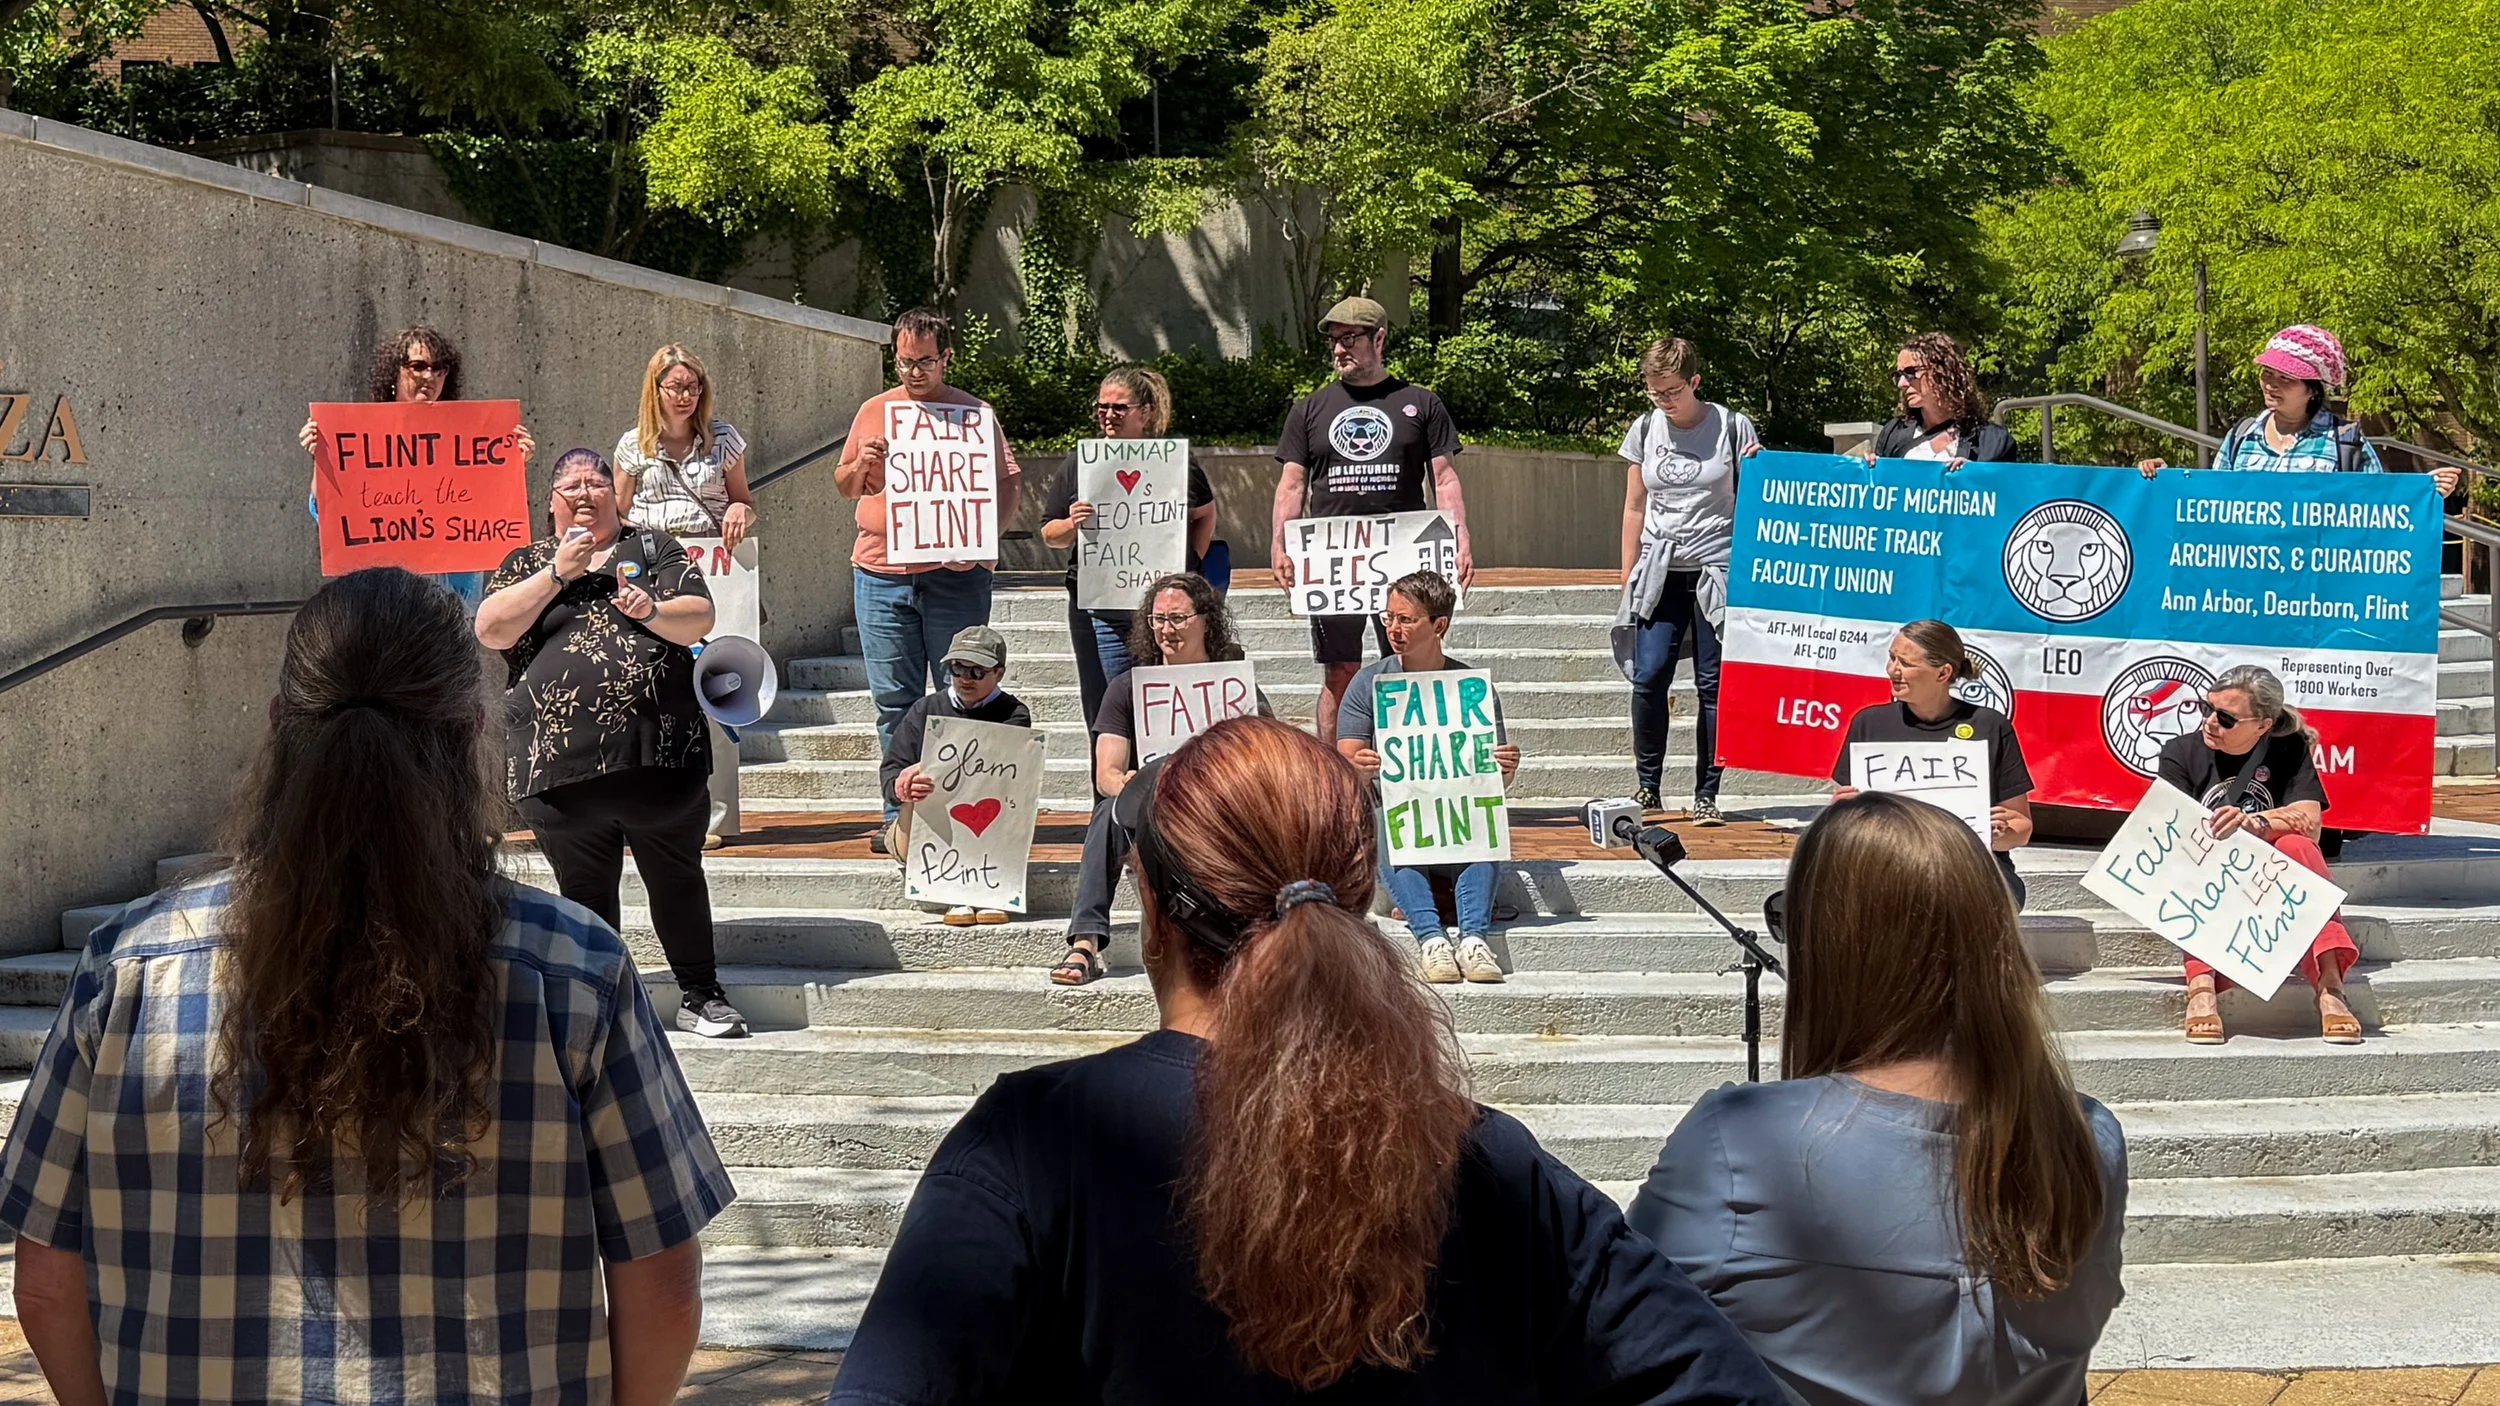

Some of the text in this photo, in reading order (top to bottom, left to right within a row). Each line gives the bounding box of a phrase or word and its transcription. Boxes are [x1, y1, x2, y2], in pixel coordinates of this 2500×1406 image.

[891, 404, 984, 444] FAIR
[336, 432, 441, 471] FLINT
[1081, 441, 1176, 464] UMMAP
[890, 451, 989, 494] SHARE
[360, 476, 473, 509] teach the
[1762, 479, 1997, 517] UNIVERSITY OF MICHIGAN
[341, 509, 525, 546] LION'S SHARE
[891, 498, 991, 551] FLINT
[2176, 498, 2415, 532] LECTURERS, LIBRARIANS,
[1299, 518, 1396, 552] FLINT
[1756, 518, 1943, 556] NON-TENURE TRACK
[1083, 541, 1144, 567] FAIR
[1303, 551, 1389, 586] LECS
[2169, 542, 2412, 575] ARCHIVISTS, & CURATORS
[1115, 570, 1172, 589] SHAR
[1751, 558, 1893, 595] FACULTY UNION
[1306, 587, 1380, 612] DESE
[2161, 586, 2410, 622] Ann Arbor, Dearborn, Flint
[1767, 621, 1868, 645] AFT-MI Local 6244
[1793, 644, 1837, 660] AFL-CIO
[2042, 648, 2082, 676] LEO
[2281, 657, 2394, 680] Representing Over
[1374, 677, 1493, 729] FAIR
[2294, 680, 2378, 698] 1800 Workers
[1776, 697, 1841, 730] LECS
[938, 738, 1017, 792] glam
[1381, 731, 1498, 783] SHARE
[1864, 754, 1978, 788] FAIR
[1386, 796, 1503, 850] FLINT
[2106, 808, 2181, 896] Fair
[2182, 817, 2218, 867] LEC
[921, 842, 1000, 889] flint
[2242, 851, 2289, 906] LECS
[2158, 847, 2255, 941] Share
[2226, 879, 2307, 974] Flint
